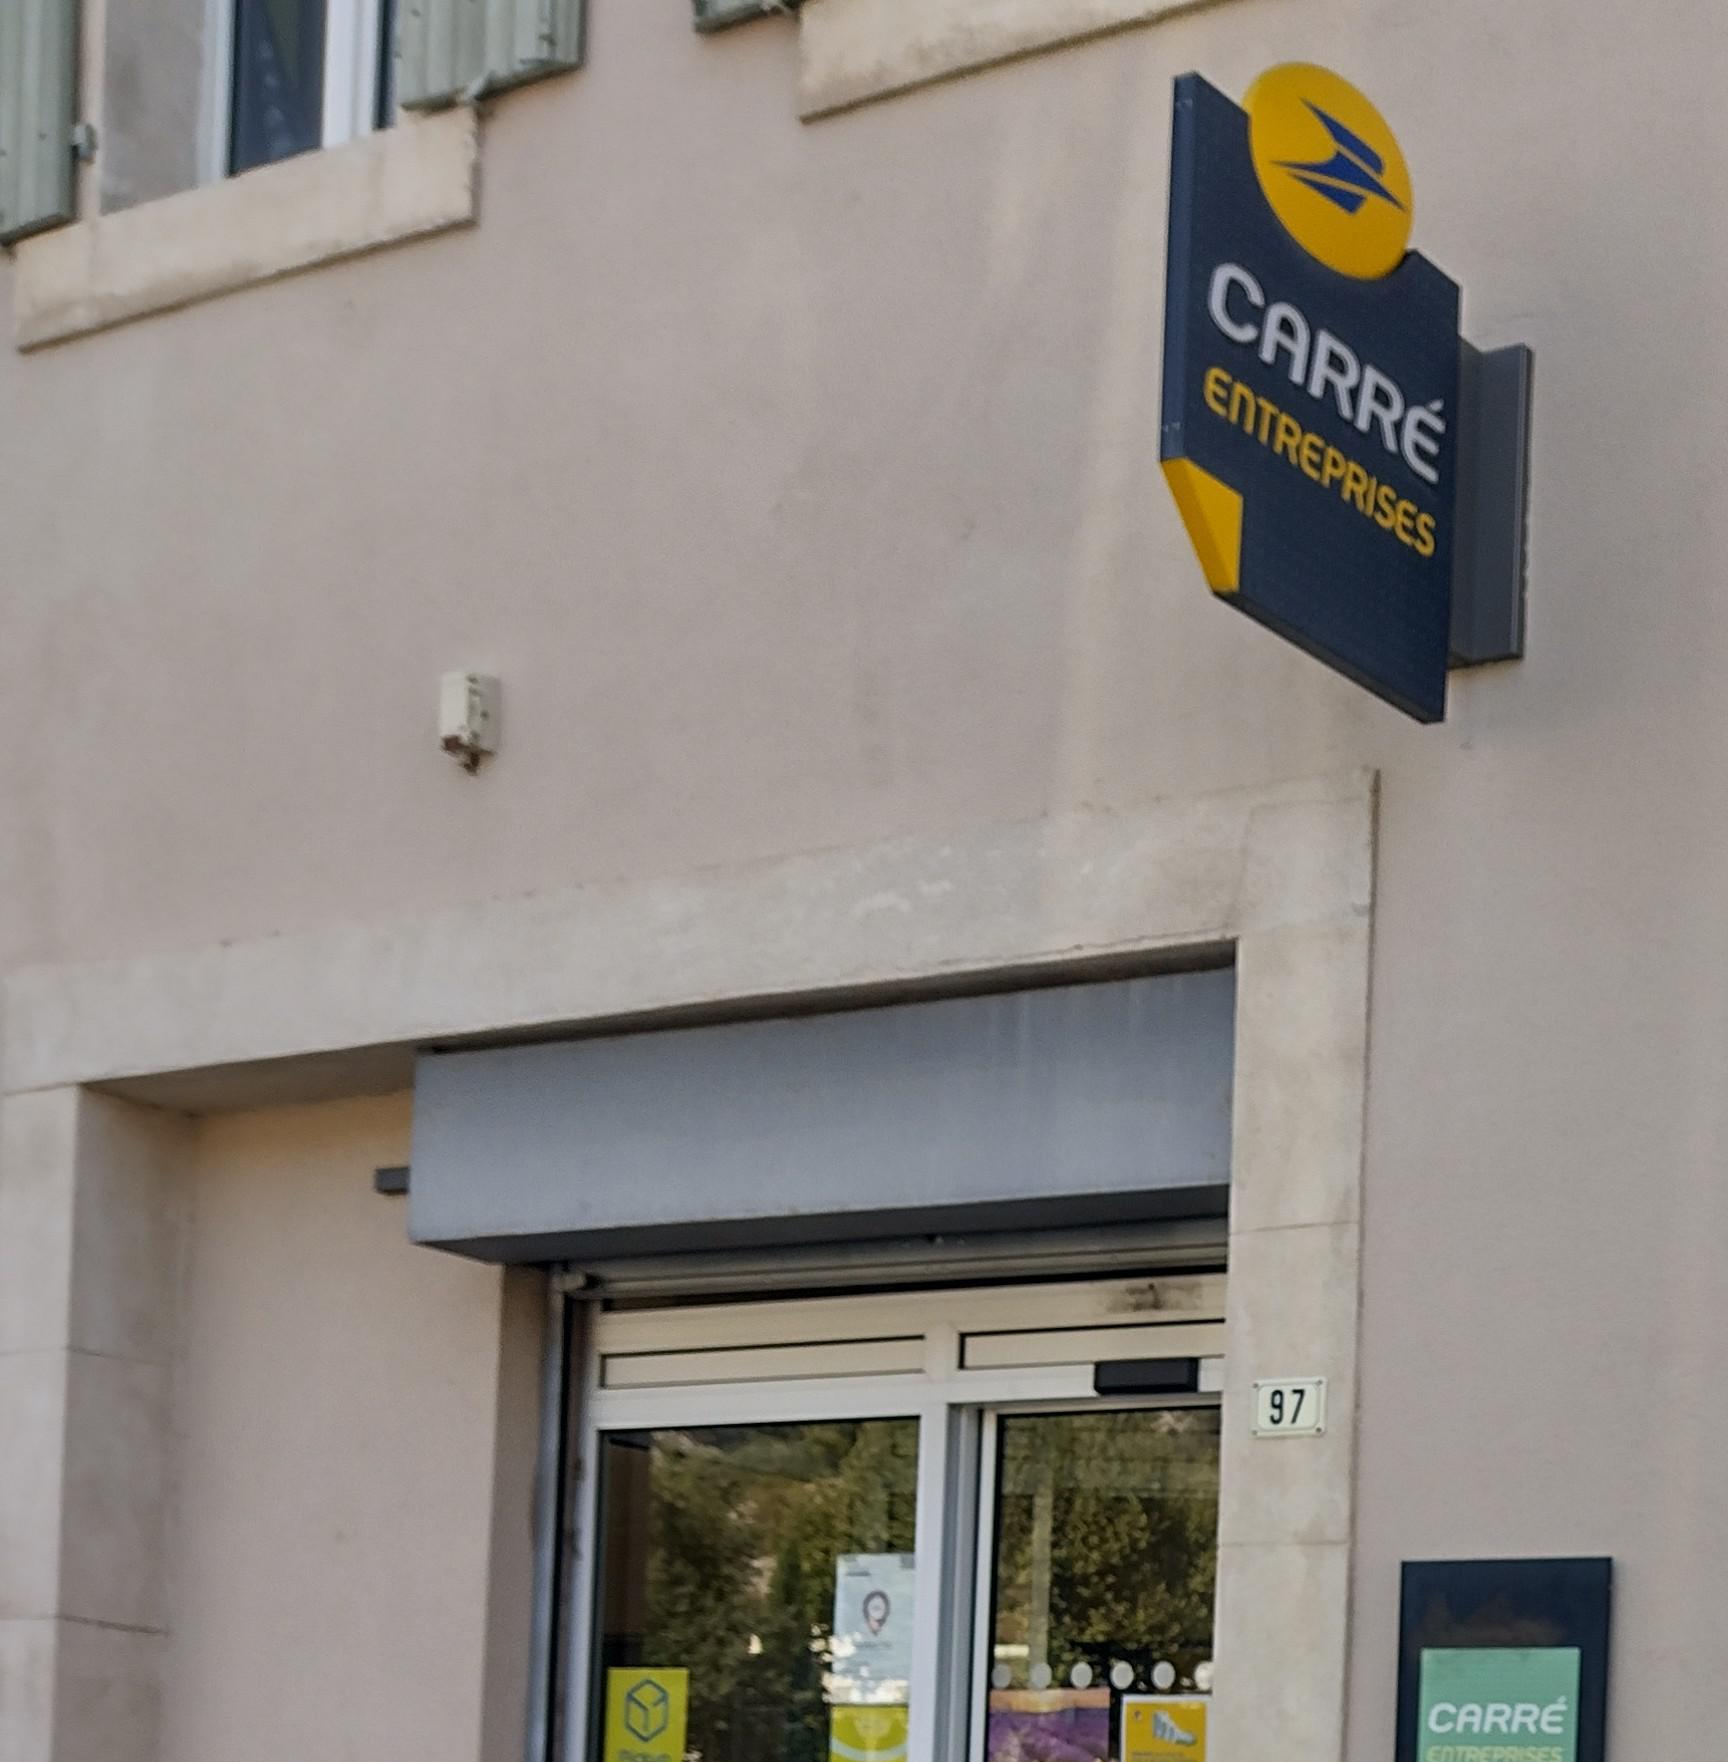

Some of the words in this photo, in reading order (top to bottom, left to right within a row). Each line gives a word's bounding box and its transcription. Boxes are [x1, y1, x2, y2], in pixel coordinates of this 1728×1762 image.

[1207, 262, 1446, 484] CARRÉ
[1203, 366, 1436, 558] ENTREPRISES
[1269, 1388, 1306, 1425] 97
[1427, 1695, 1569, 1735] CARRÉ
